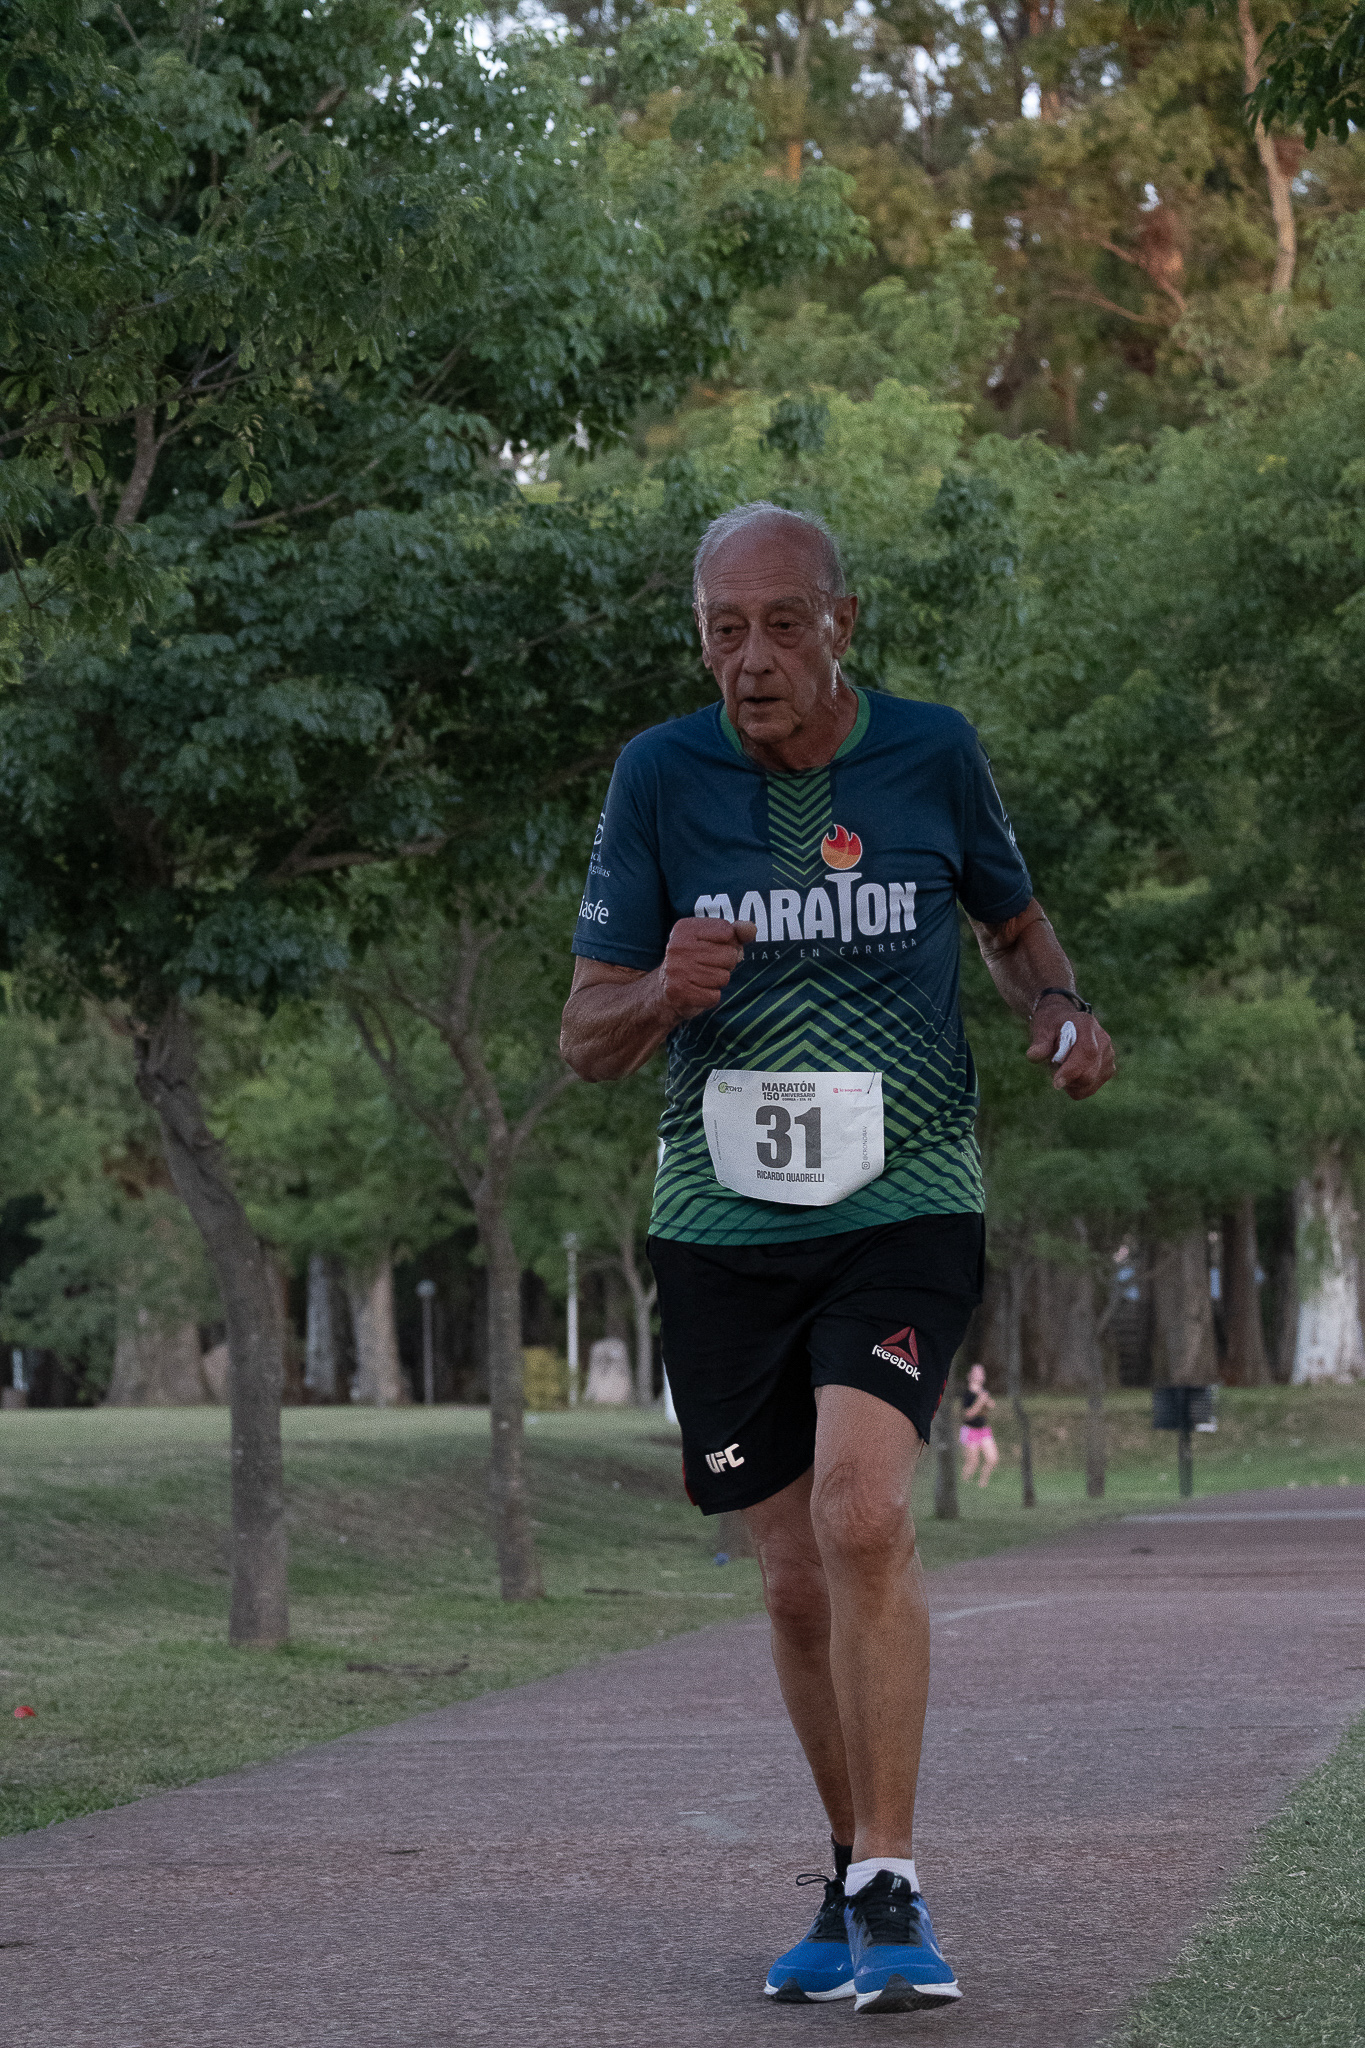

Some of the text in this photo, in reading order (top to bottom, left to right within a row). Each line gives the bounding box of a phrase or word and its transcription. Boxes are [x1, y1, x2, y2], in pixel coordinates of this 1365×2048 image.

[800, 948, 820, 958] EN
[839, 938, 917, 956] CARRERA
[761, 1080, 816, 1092] MARATÓN
[762, 1092, 780, 1101] 150
[755, 1105, 822, 1169] 31
[756, 1169, 825, 1183] RICARDO QUADRELLI
[871, 1344, 921, 1381] Reebok
[705, 1443, 745, 1474] UFC
